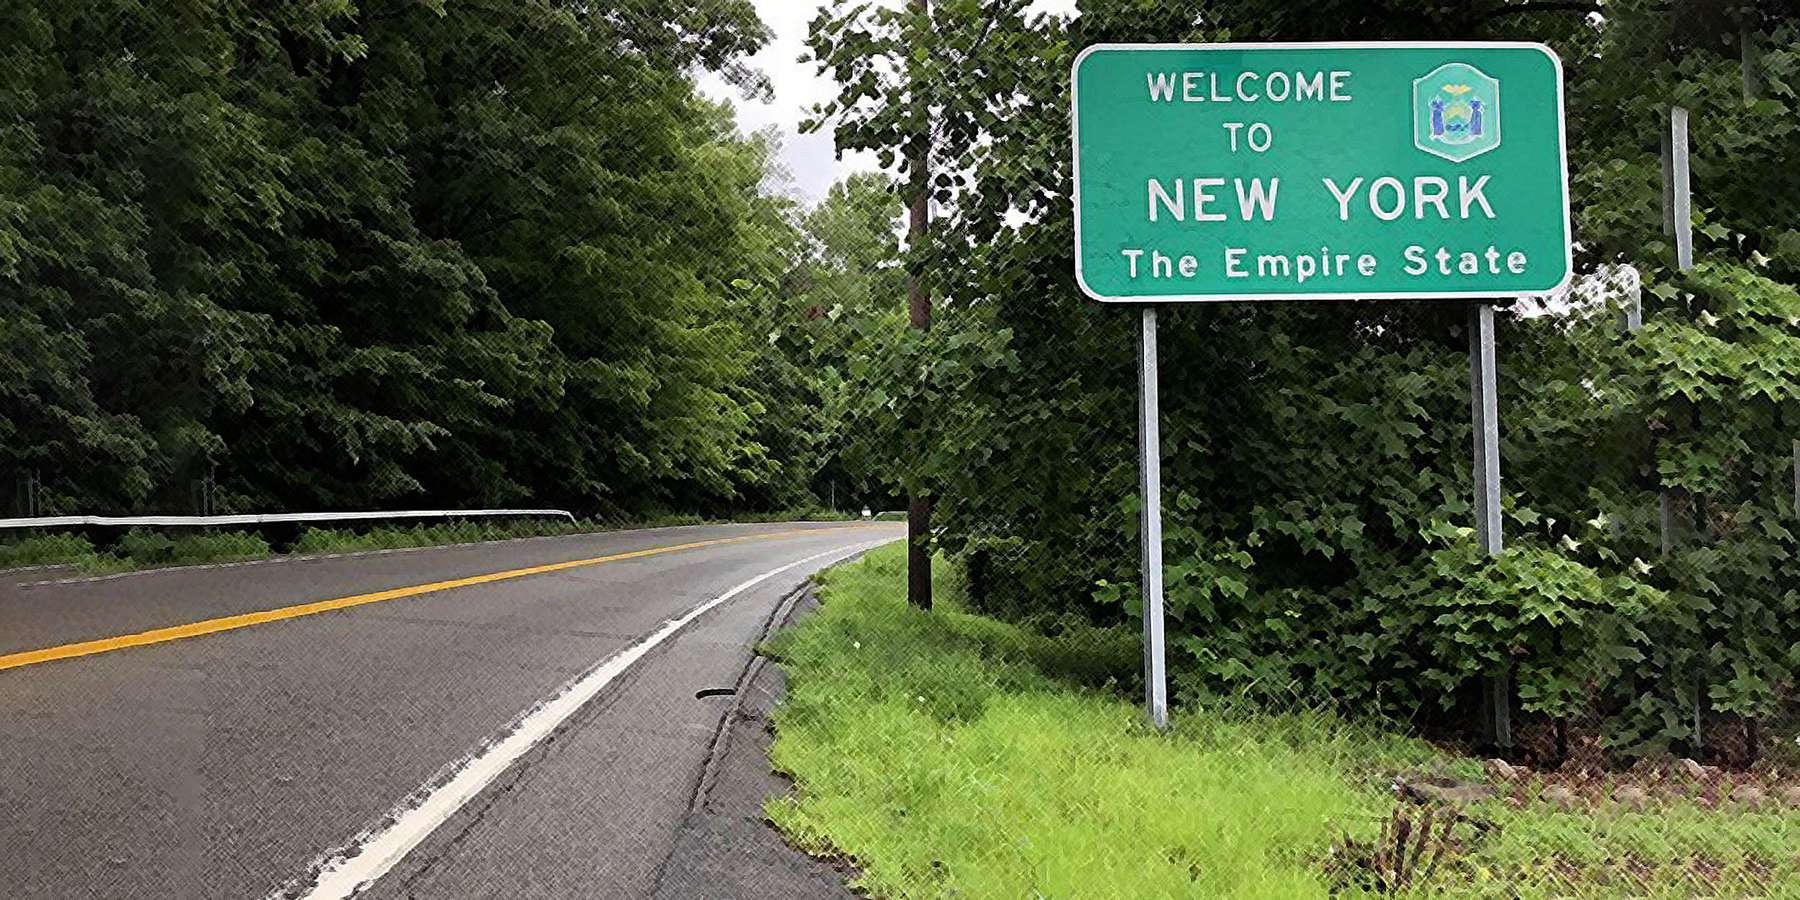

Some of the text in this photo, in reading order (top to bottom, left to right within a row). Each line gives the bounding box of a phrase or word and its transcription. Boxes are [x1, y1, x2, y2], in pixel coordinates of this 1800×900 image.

[1146, 71, 1353, 102] WELCOME
[1222, 122, 1272, 153] TO
[1148, 175, 1496, 222] NEW YORK
[1121, 245, 1527, 284] The Empire State
